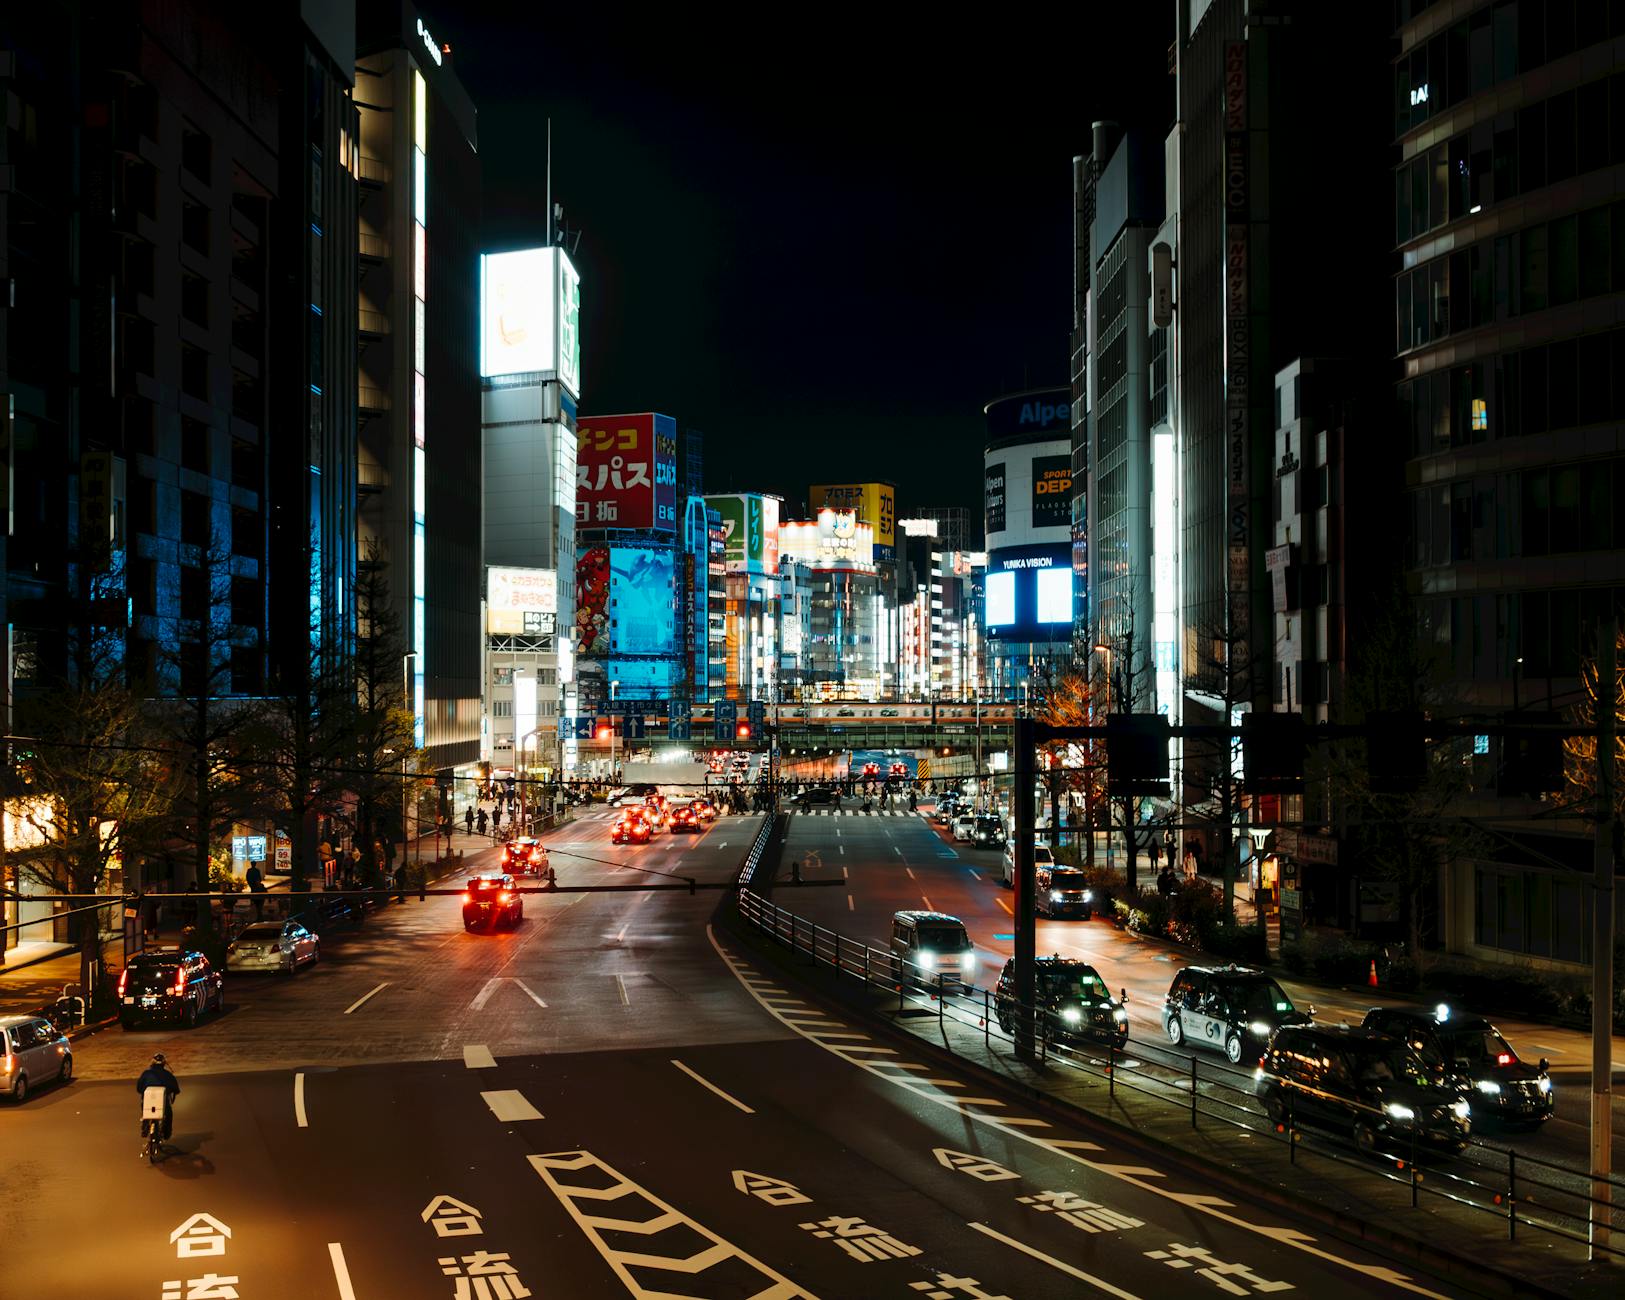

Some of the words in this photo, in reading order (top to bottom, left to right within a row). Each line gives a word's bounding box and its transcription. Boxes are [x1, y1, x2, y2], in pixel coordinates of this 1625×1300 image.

[1232, 318, 1247, 386] BOXING
[656, 460, 677, 486] エスパス
[824, 487, 865, 498] プロミス
[751, 500, 760, 551] レイク
[1003, 559, 1026, 570] YUNIKA
[1026, 557, 1053, 568] VISION
